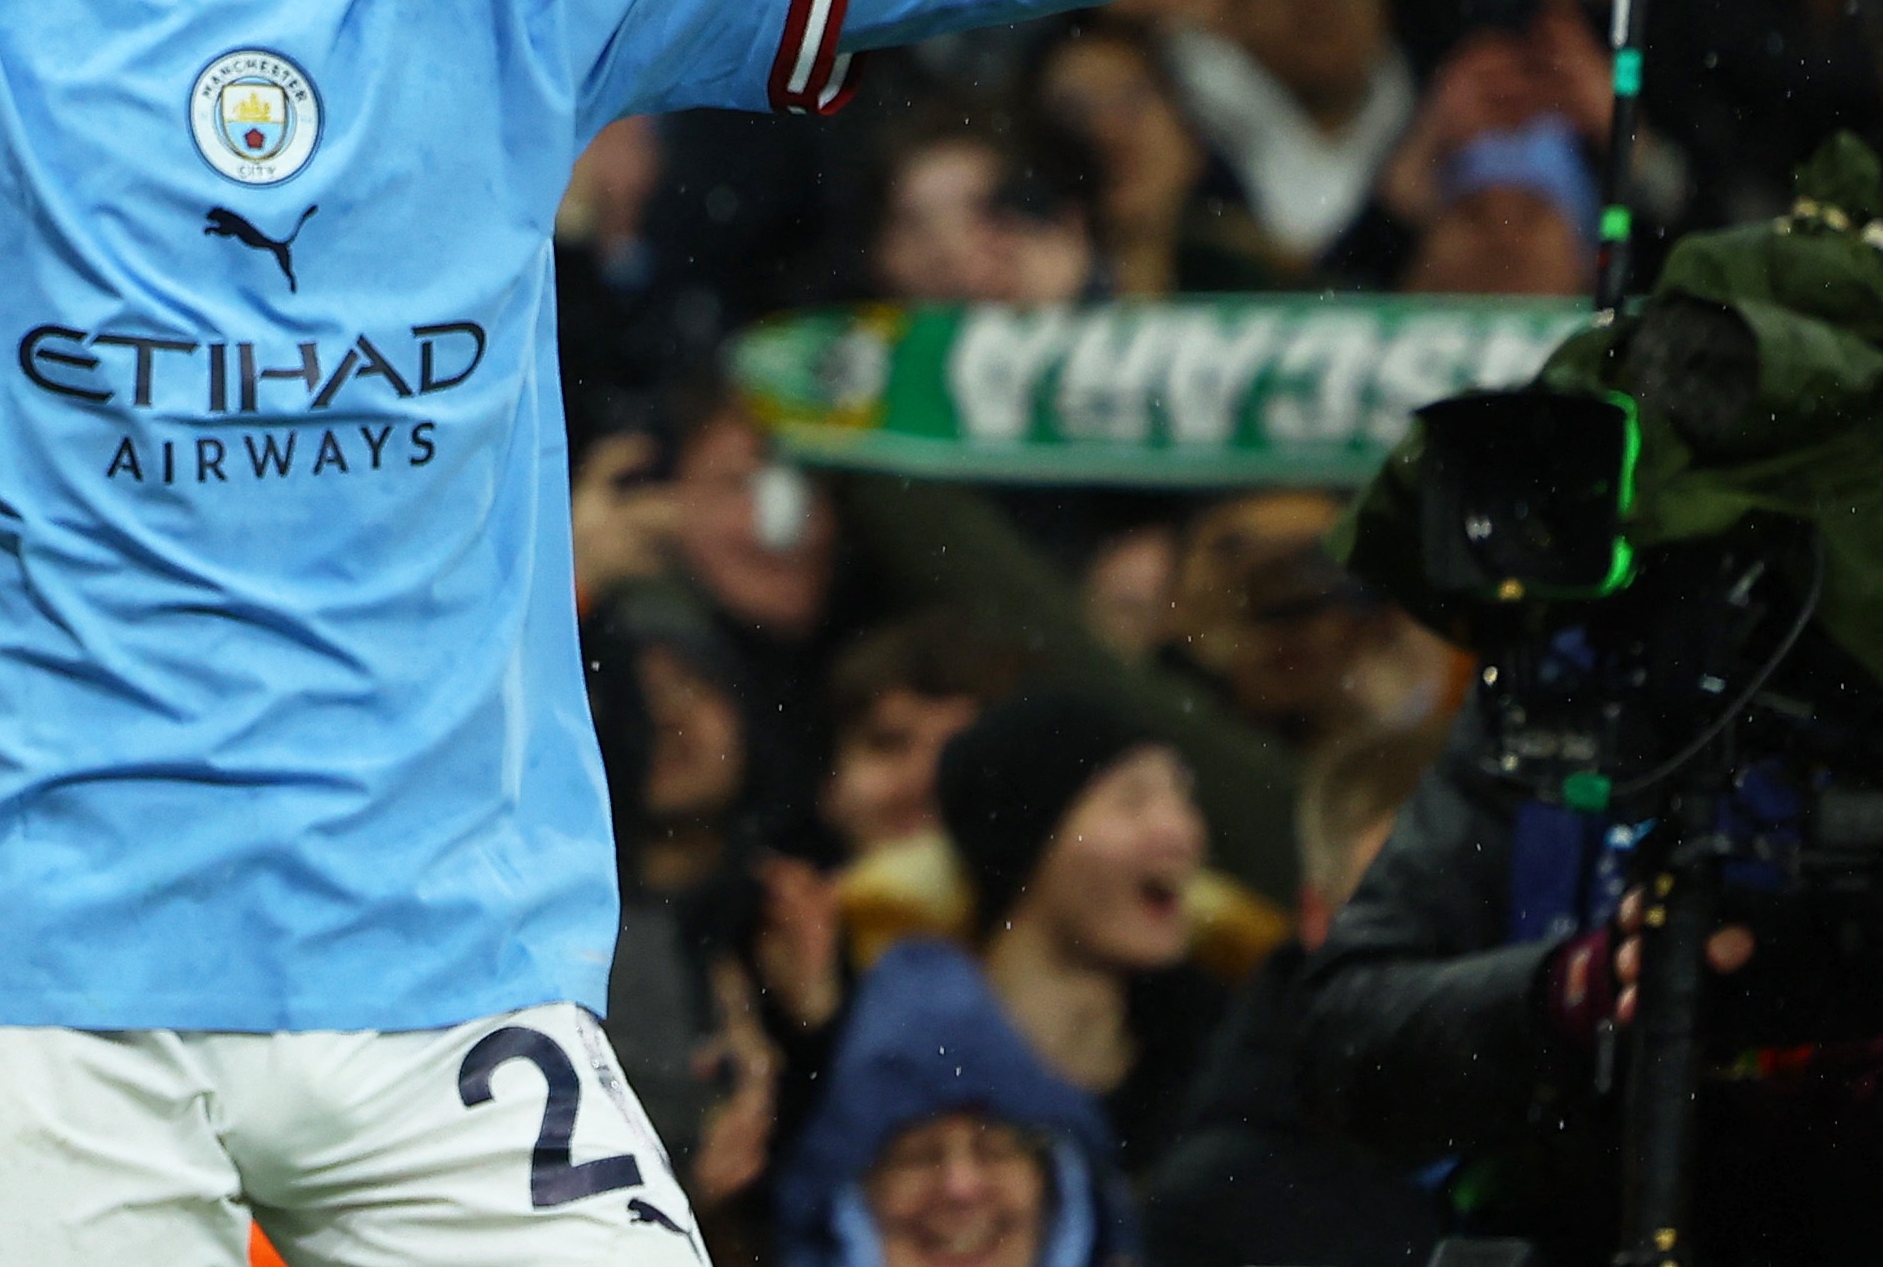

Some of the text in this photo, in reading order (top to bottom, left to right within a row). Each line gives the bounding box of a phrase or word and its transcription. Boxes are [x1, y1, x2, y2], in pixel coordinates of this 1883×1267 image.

[201, 59, 308, 103] MANCHESTER
[238, 165, 277, 178] CITY
[19, 321, 487, 413] ETIHAD
[106, 422, 437, 485] AIRWAYS
[458, 1026, 645, 1210] 2
